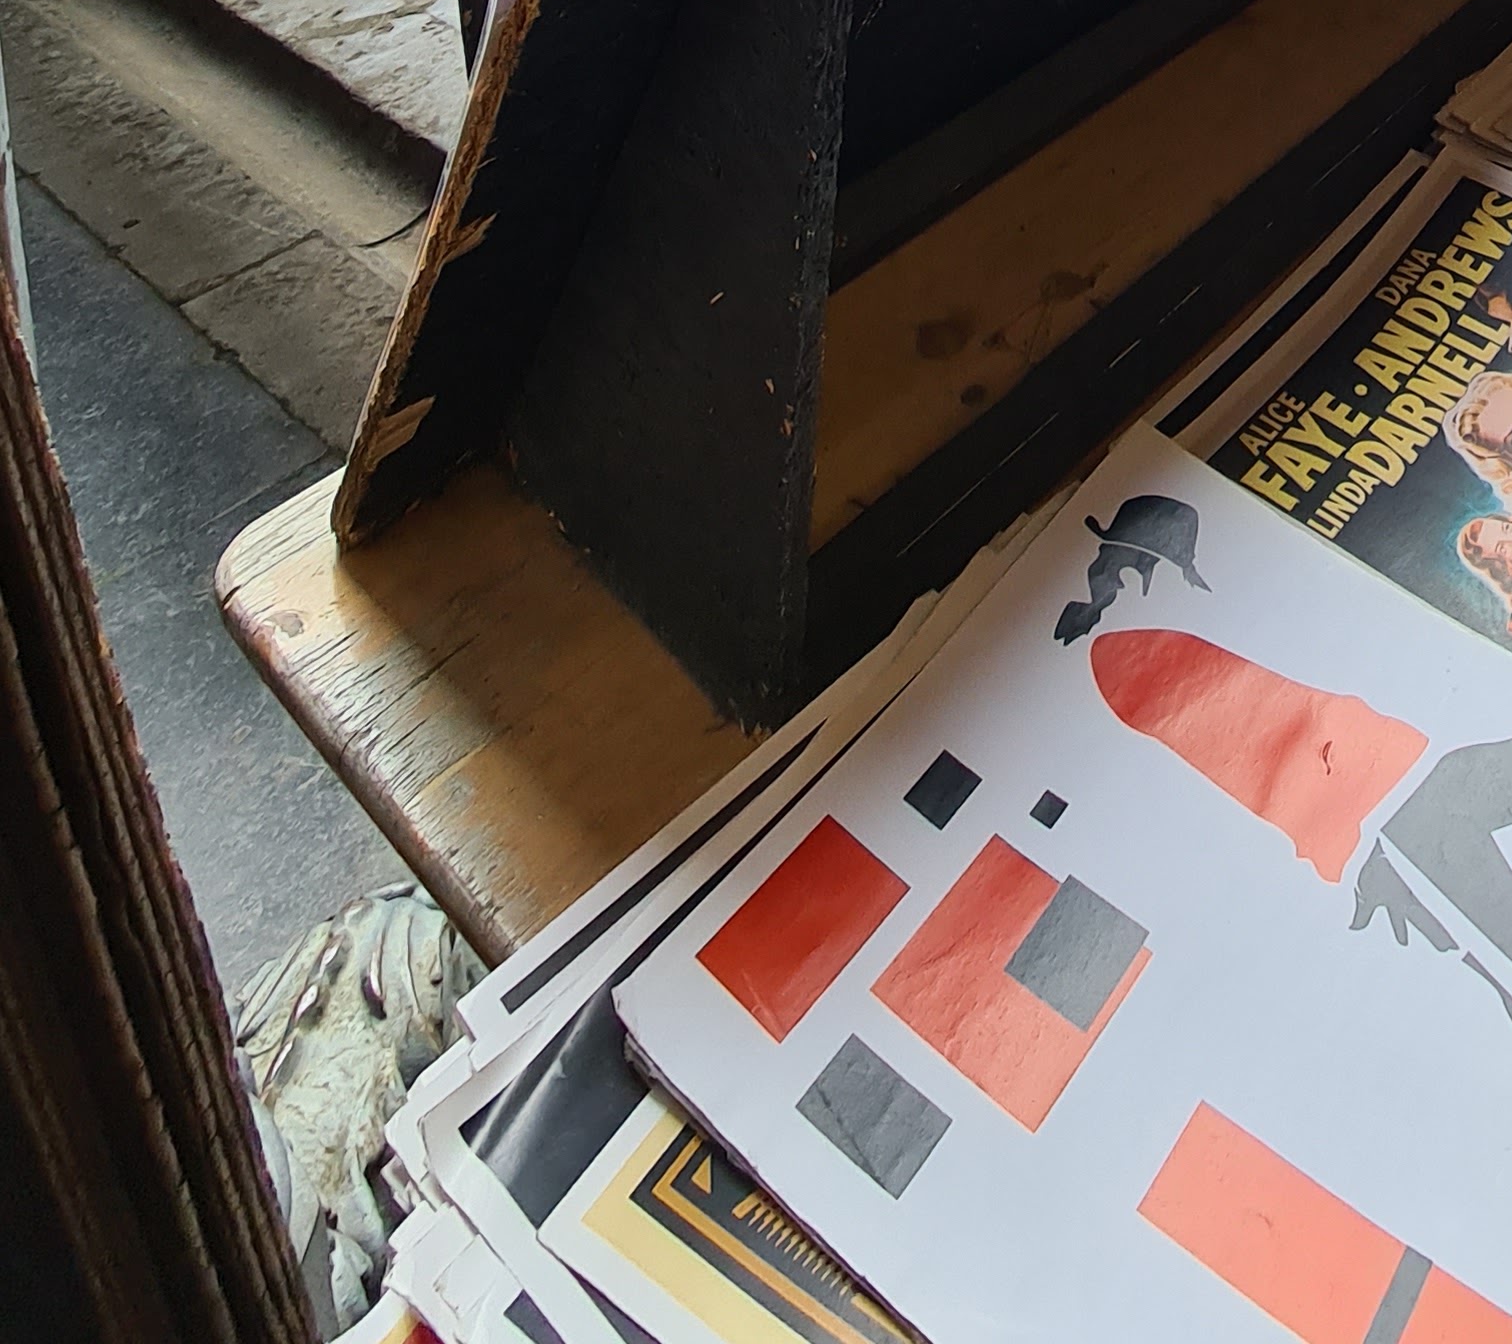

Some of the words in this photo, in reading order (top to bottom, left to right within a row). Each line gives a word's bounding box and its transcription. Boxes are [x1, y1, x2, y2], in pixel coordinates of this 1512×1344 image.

[1375, 248, 1437, 306] DANA
[1238, 391, 1305, 457] ALICE
[1239, 391, 1373, 512] FAYE
[1306, 467, 1381, 540] LINDA
[1344, 314, 1512, 487] DARNELL
